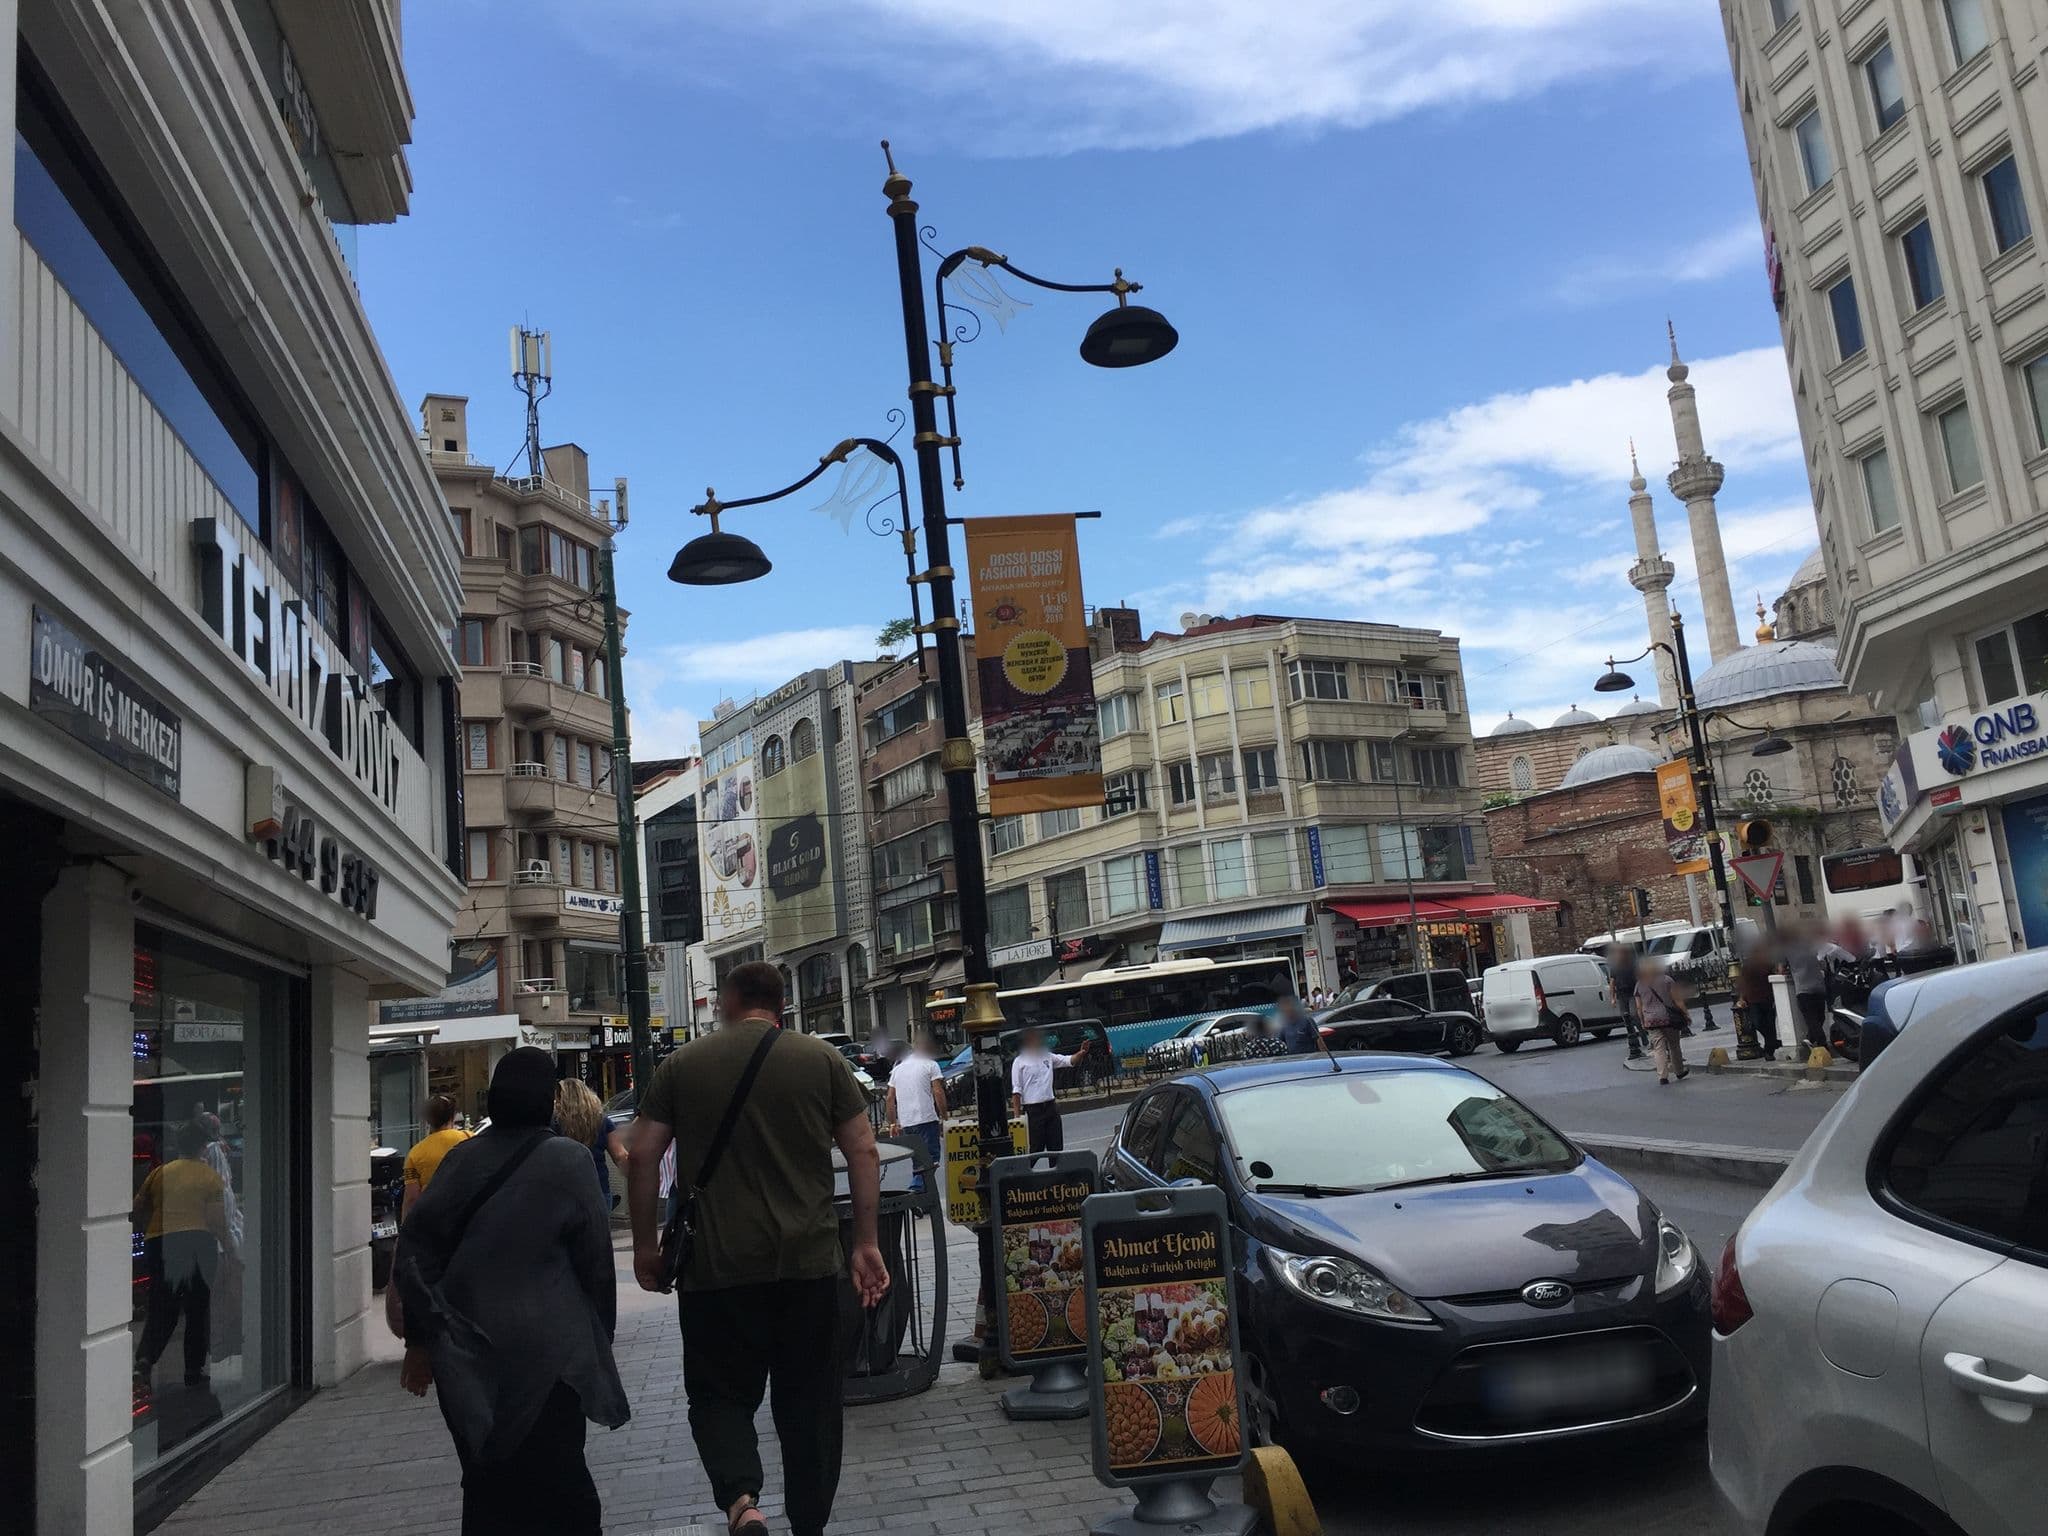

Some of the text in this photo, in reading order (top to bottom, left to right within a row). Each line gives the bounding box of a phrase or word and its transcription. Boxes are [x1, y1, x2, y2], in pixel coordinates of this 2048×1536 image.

[990, 549, 1063, 567] DOSSO DOSSI
[980, 562, 1063, 580] FASHION SHOW
[210, 518, 330, 747] TEMİZ
[40, 622, 179, 773] ÖMÜR İŞ MERKEZİ
[1974, 703, 2037, 745] QNB
[772, 854, 798, 877] BLACK
[798, 845, 821, 866] GOLD
[1005, 1181, 1090, 1205] Ahmet Efendi
[1007, 1206, 1033, 1218] Baklava
[1040, 1203, 1065, 1216] Turkish
[1102, 1230, 1217, 1260] Ahmet Efendi
[1103, 1258, 1218, 1278] Baklava & Turkish Delight
[1534, 1285, 1562, 1300] Ford
